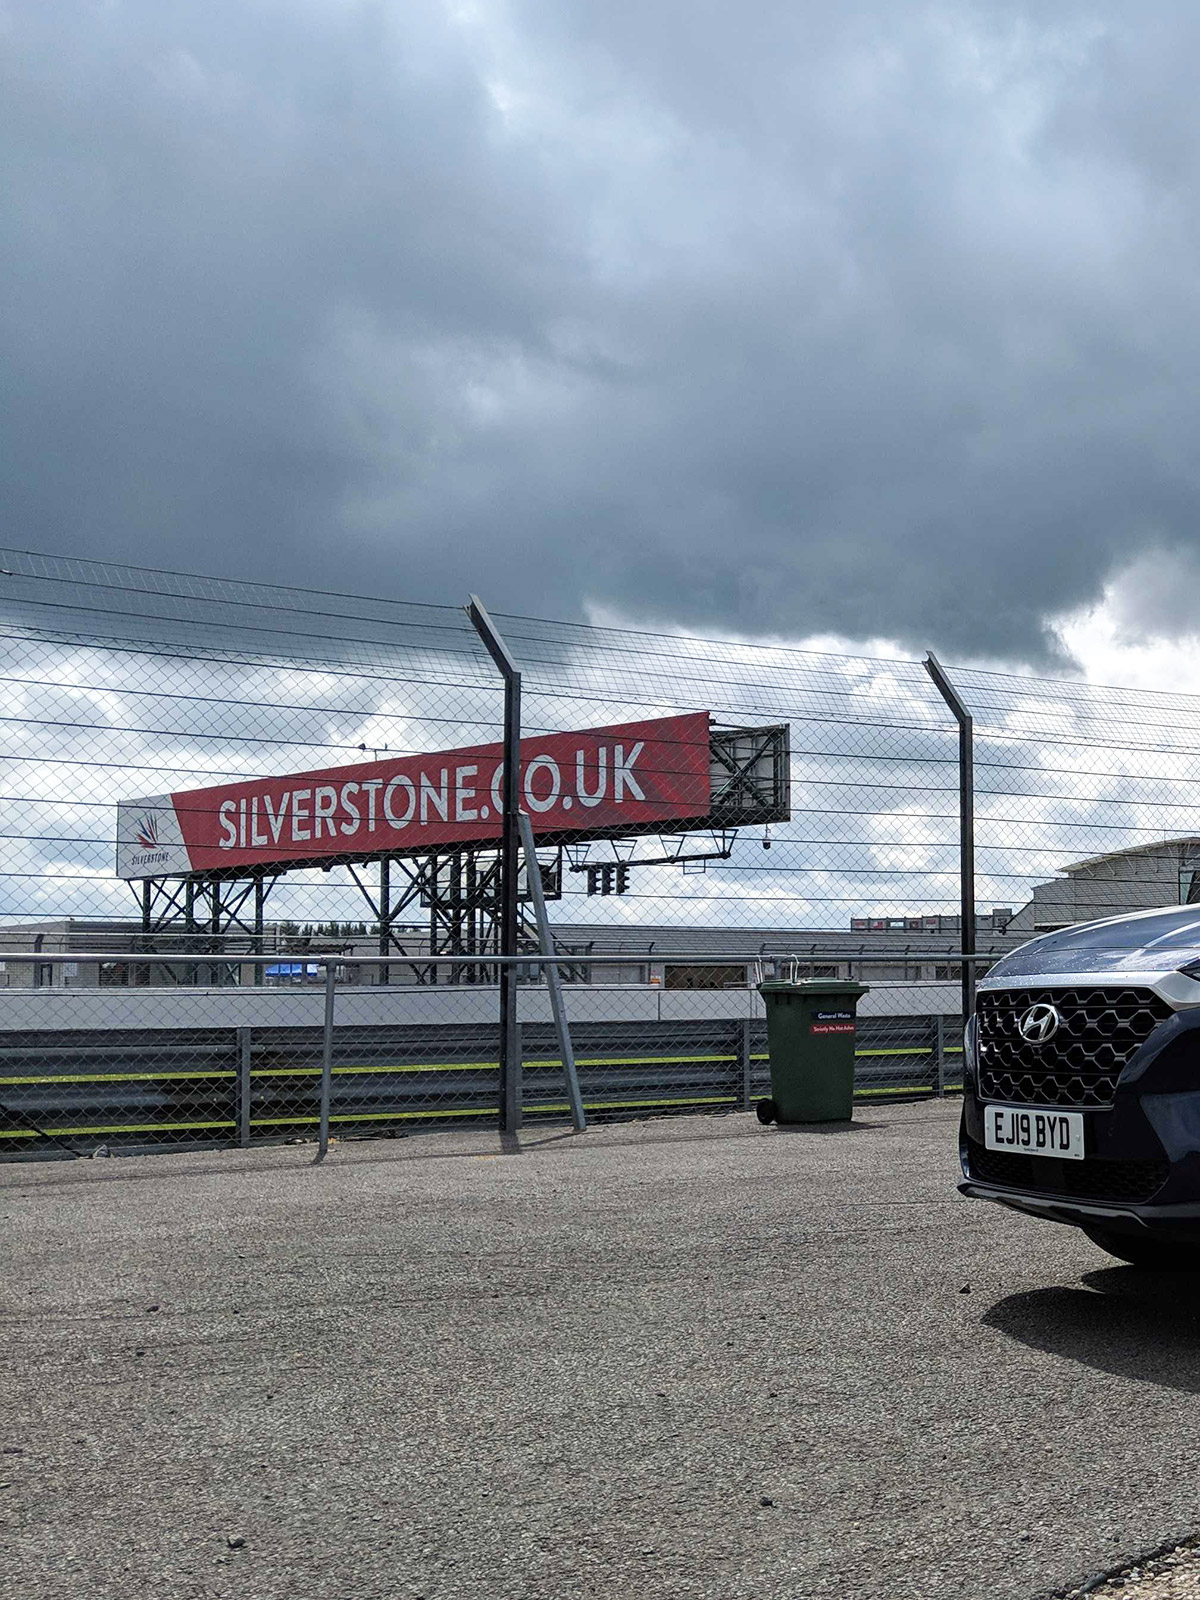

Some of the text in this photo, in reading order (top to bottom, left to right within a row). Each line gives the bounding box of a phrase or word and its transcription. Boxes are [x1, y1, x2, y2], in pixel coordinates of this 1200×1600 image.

[131, 852, 169, 865] SILVERSTONE
[995, 1112, 1070, 1150] EJ19 BYD
